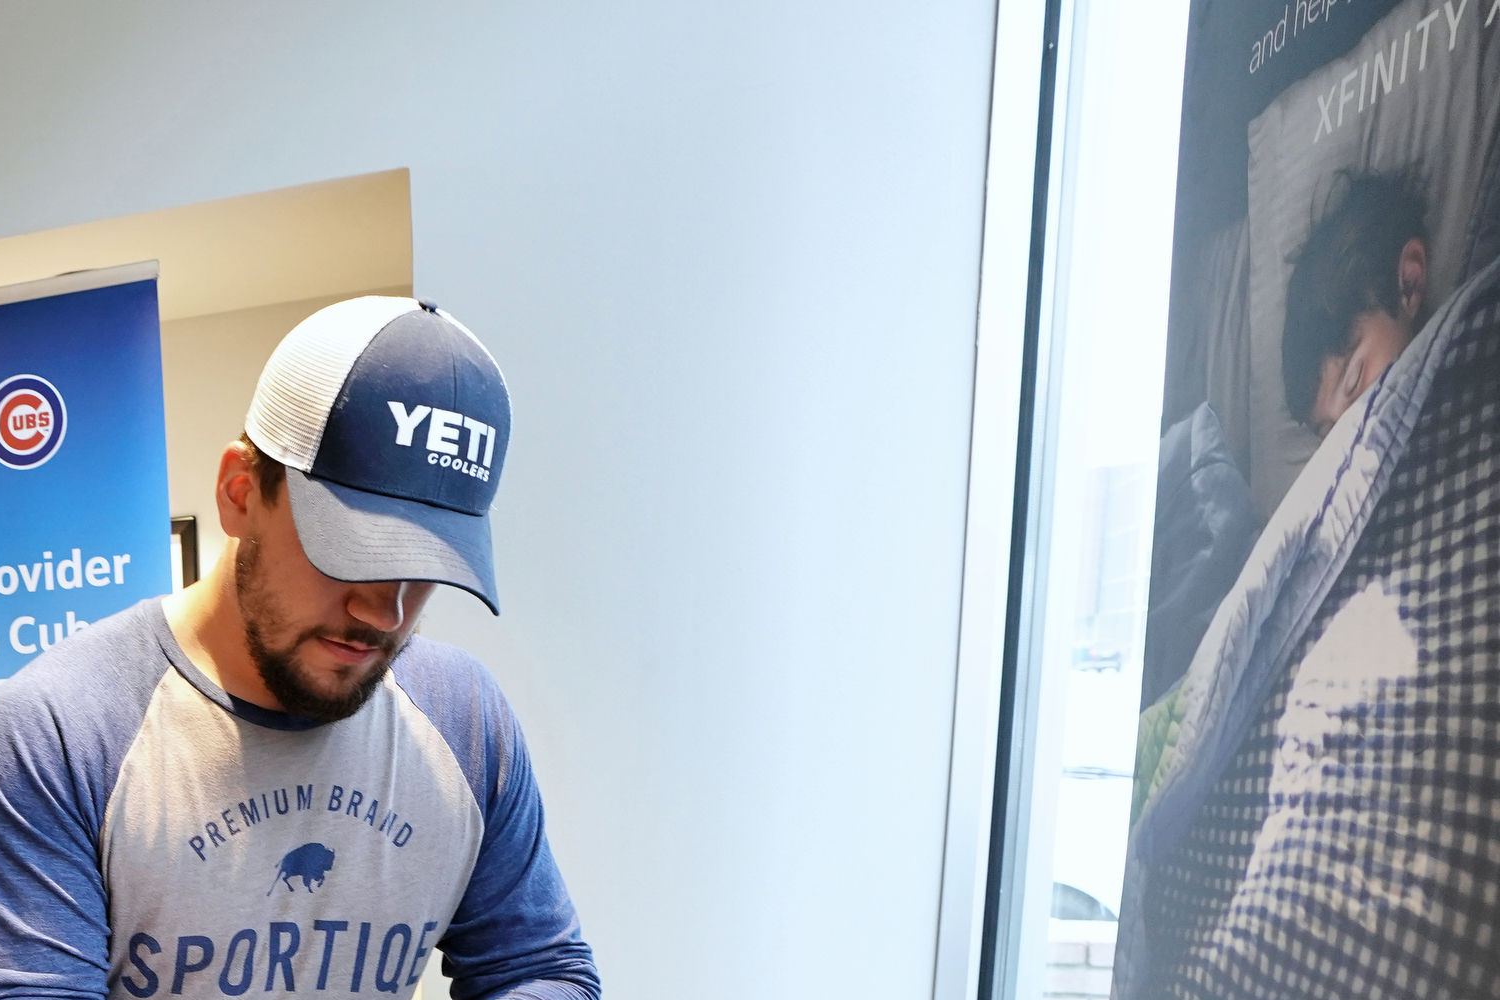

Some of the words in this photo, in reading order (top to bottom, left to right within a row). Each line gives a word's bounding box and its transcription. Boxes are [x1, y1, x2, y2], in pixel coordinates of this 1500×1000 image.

[1249, 4, 1289, 74] and
[1313, 0, 1468, 144] XFINITY
[386, 400, 497, 469] YETI
[427, 452, 490, 483] COOLERS
[188, 783, 314, 862] PREMIUM
[327, 785, 414, 848] BRAND
[121, 919, 439, 999] SPORTIQE
